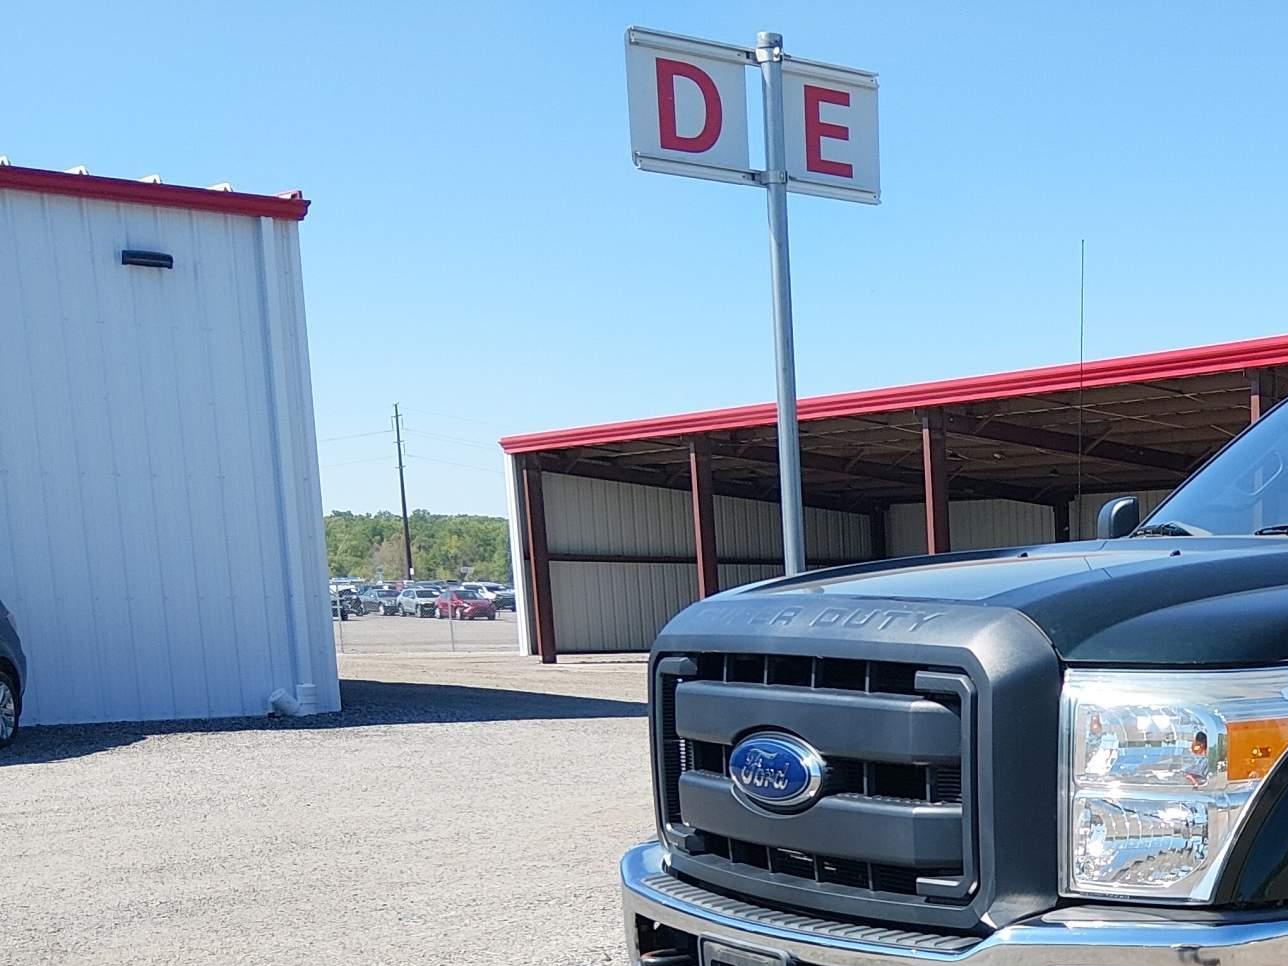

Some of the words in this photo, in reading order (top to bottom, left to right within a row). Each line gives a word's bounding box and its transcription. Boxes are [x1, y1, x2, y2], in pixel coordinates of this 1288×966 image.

[655, 57, 723, 153] D
[803, 84, 853, 178] E
[808, 606, 946, 632] DUTY
[741, 748, 790, 790] Ford
